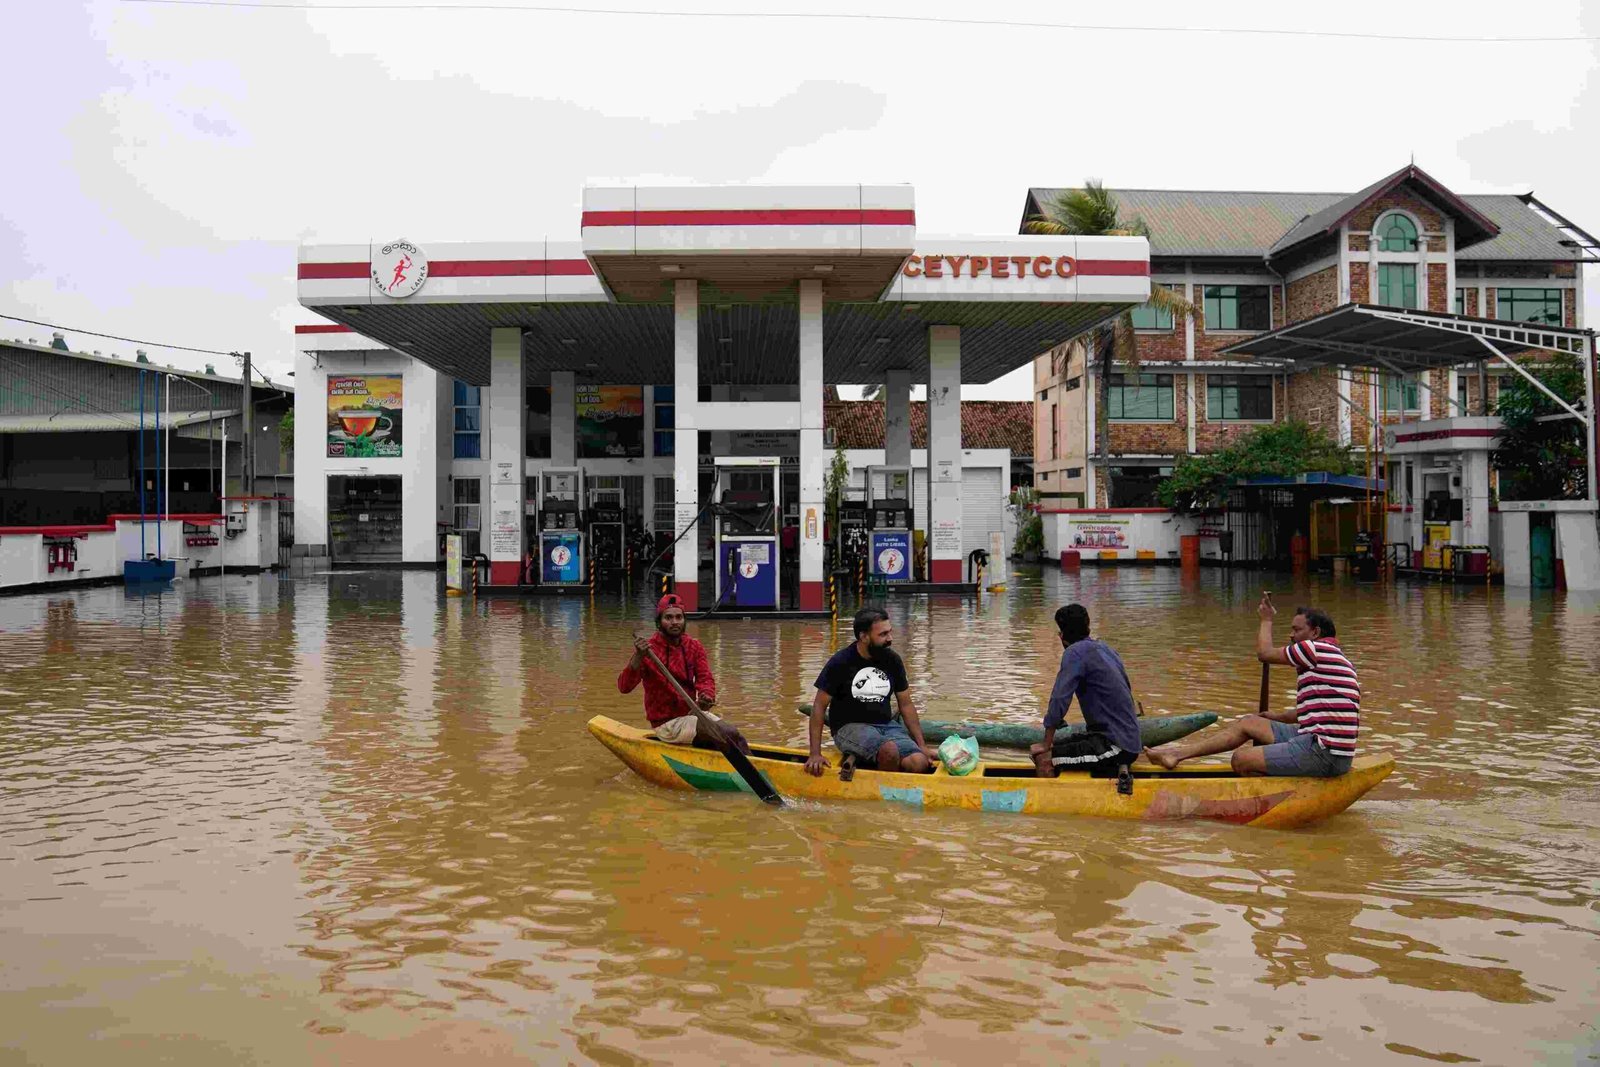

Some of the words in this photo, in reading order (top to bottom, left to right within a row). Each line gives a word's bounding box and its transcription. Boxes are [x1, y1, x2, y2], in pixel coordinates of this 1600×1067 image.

[381, 243, 417, 255] ලංකා
[410, 265, 426, 291] LANKA
[903, 255, 1077, 278] CEYPETCO
